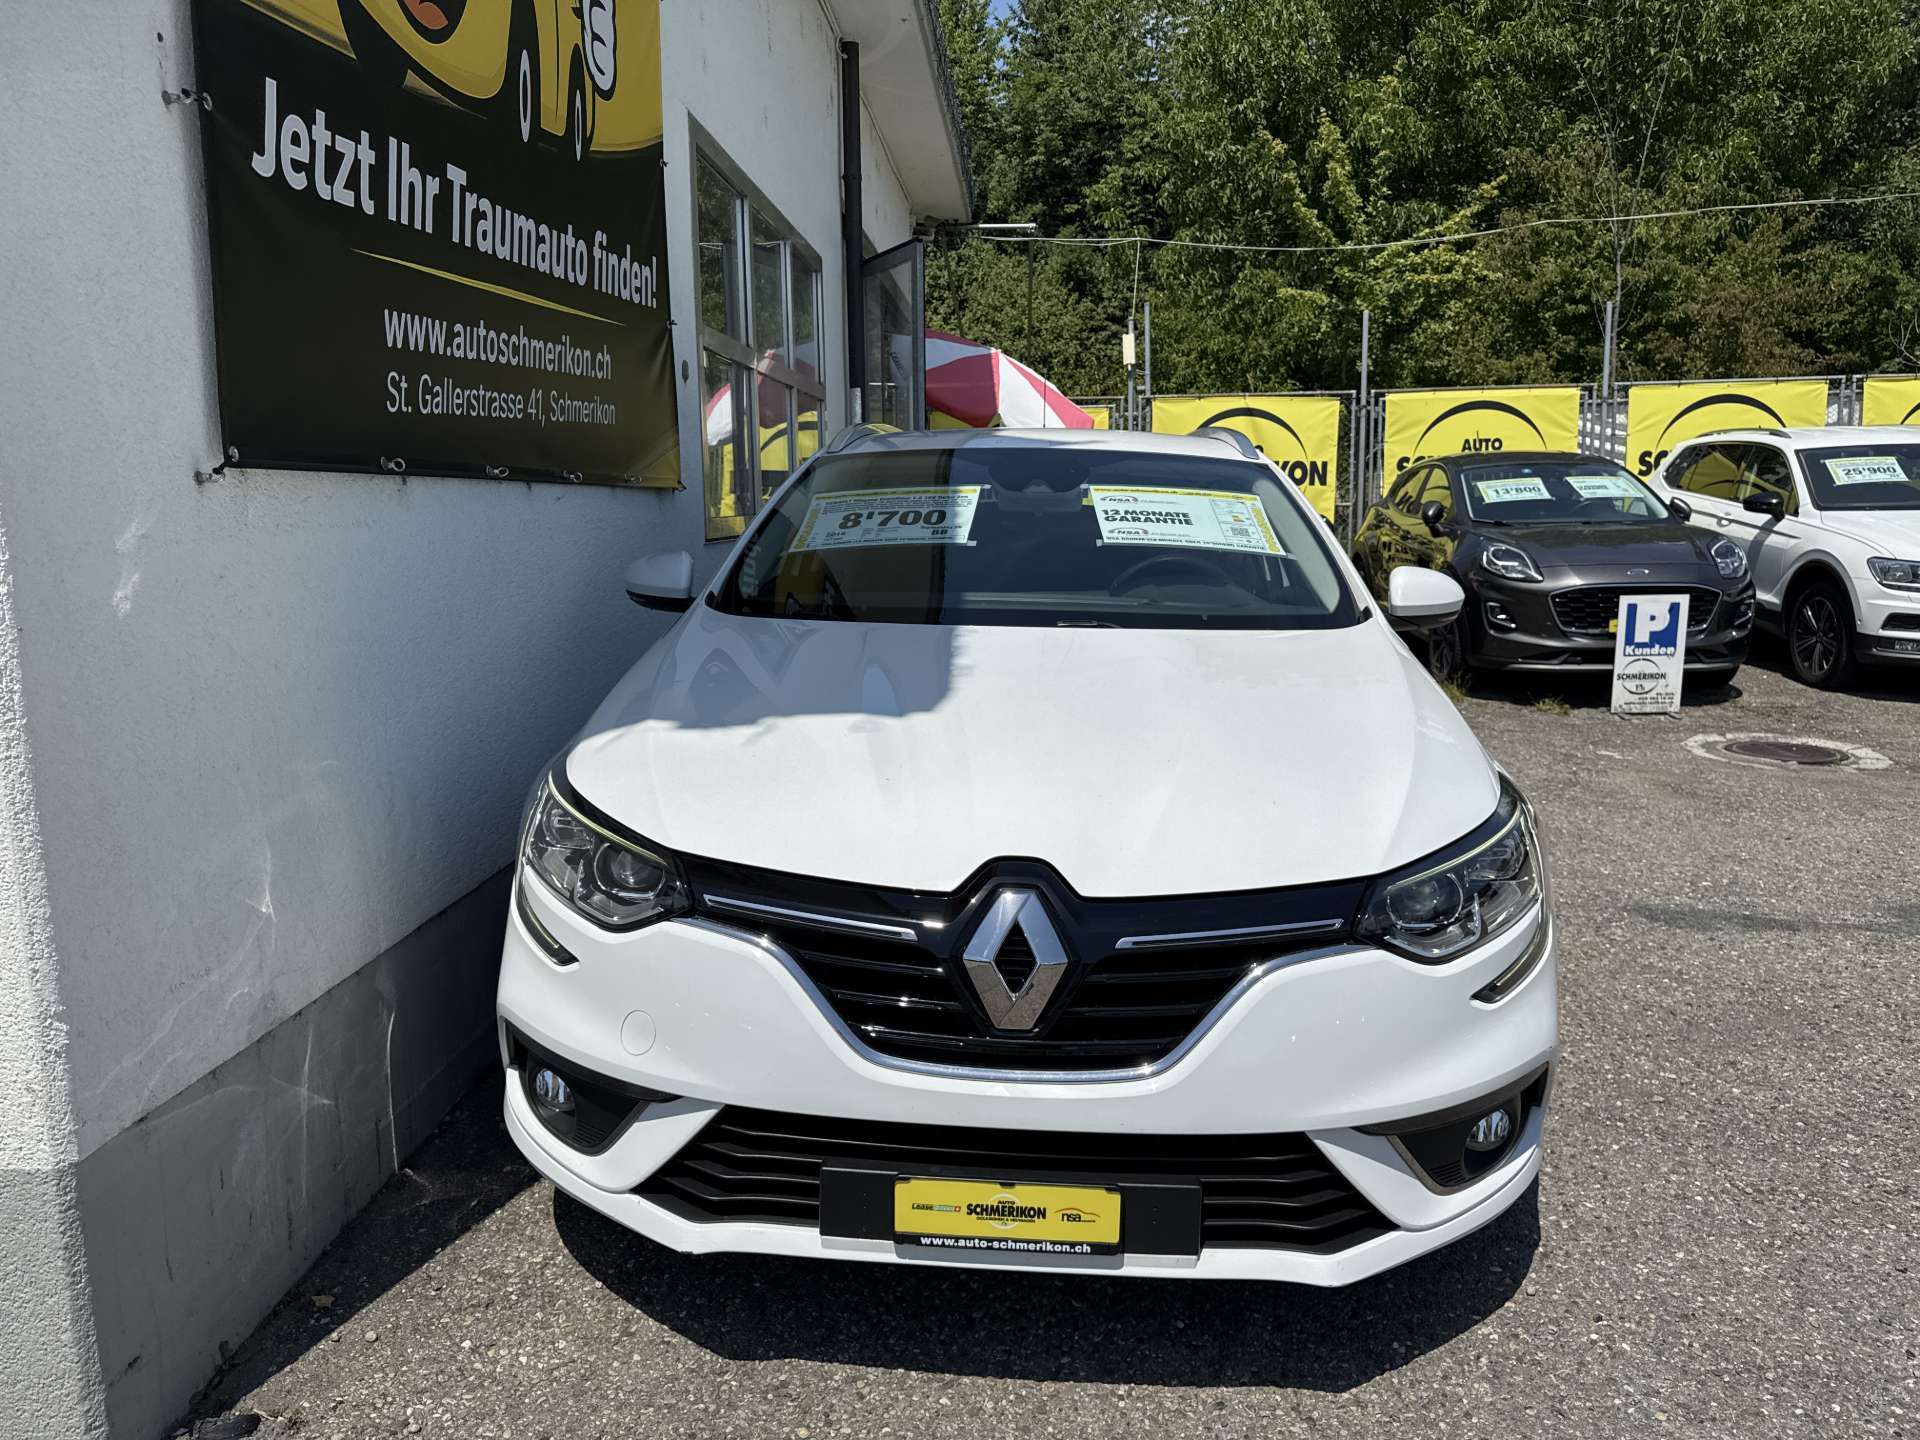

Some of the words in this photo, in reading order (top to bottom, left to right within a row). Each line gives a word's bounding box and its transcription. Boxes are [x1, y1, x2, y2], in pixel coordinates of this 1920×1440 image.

[251, 76, 376, 216] Jetzt
[387, 136, 440, 235] Ihr
[446, 163, 588, 287] Traumauto
[593, 230, 657, 309] finden!
[383, 308, 612, 381] www.autoschmerikon.ch
[386, 370, 413, 414] St.
[418, 373, 524, 421] Gallerstrasse
[526, 389, 546, 428] 41,
[549, 390, 616, 426] Schmerikon
[1461, 437, 1503, 452] AUTO
[1841, 466, 1897, 476] 25'900
[1492, 485, 1541, 496] 13'800
[838, 509, 947, 530] 8'700
[1101, 508, 1118, 517] 12
[1125, 509, 1191, 519] MONATE
[1104, 515, 1194, 526] GARANTIE
[1634, 602, 1671, 643] P
[1625, 644, 1676, 655] Kunden
[1616, 672, 1667, 681] SCHMERIKON
[966, 1202, 1047, 1221] SCHMERIKON
[1061, 1212, 1081, 1223] nsa
[920, 1236, 1092, 1254] www.auto-schmerikon.ch
